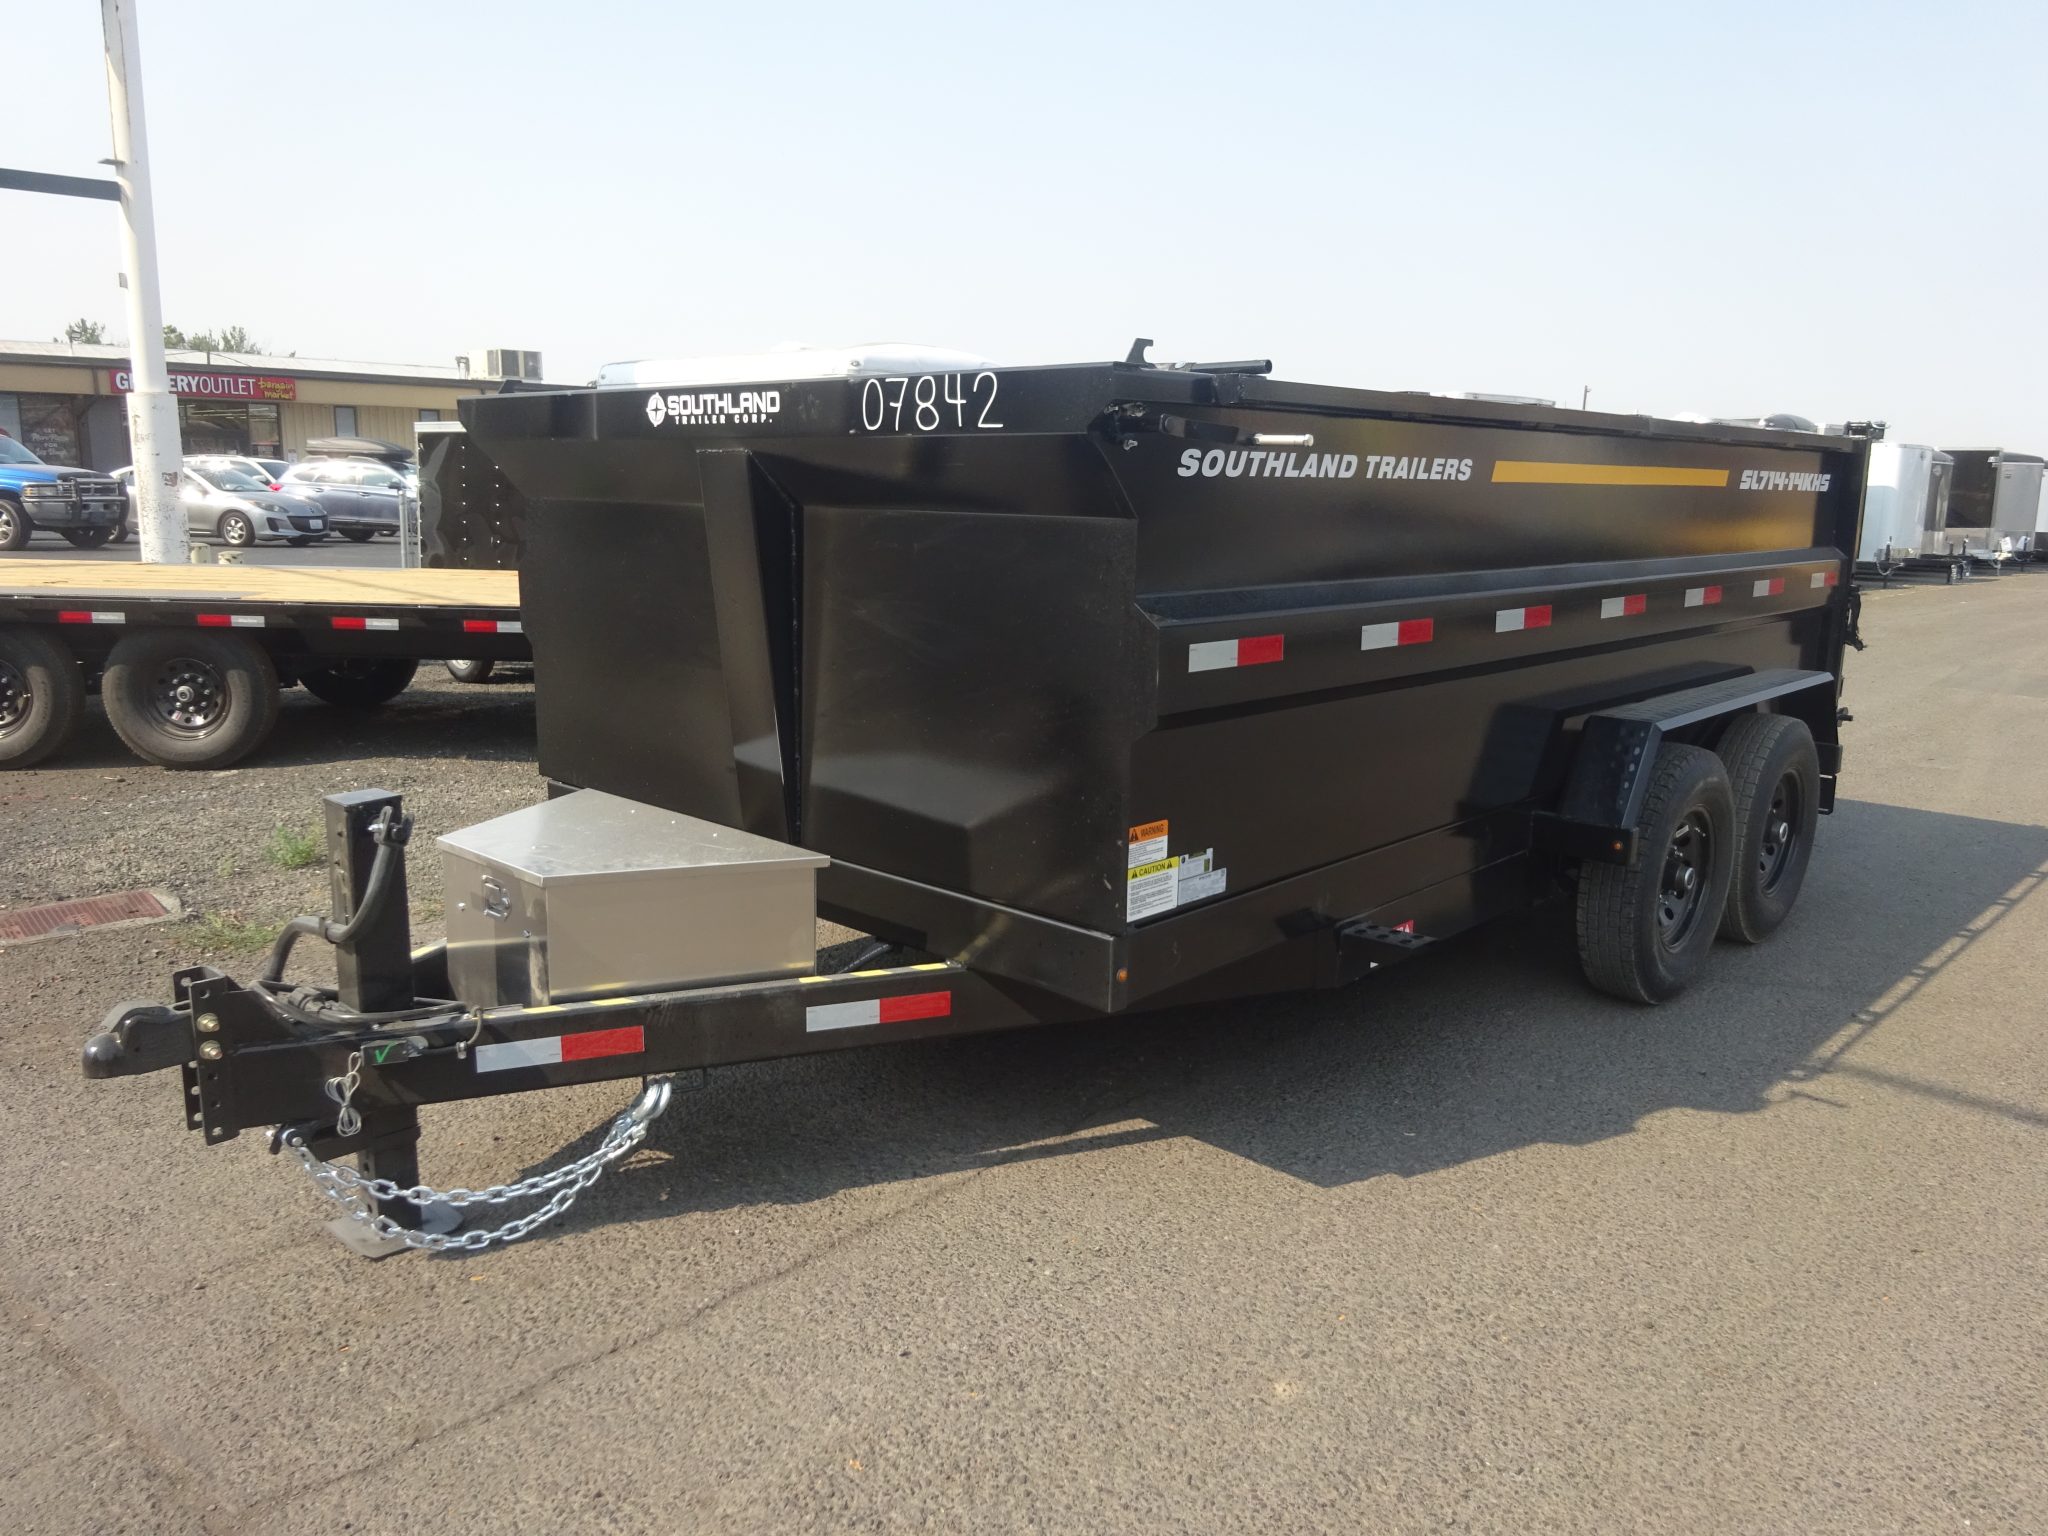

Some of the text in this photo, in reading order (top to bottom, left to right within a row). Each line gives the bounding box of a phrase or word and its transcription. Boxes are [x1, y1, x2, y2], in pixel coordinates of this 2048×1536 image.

[257, 376, 295, 391] bargain
[264, 390, 294, 400] market
[862, 372, 1004, 431] 07842
[667, 391, 780, 416] SOUTHLAND
[674, 413, 773, 425] TRAILER CORP.
[1177, 448, 1473, 481] SOUTHLAND TRAILERS
[1140, 823, 1164, 837] WARNING
[1138, 862, 1167, 876] CAUTION
